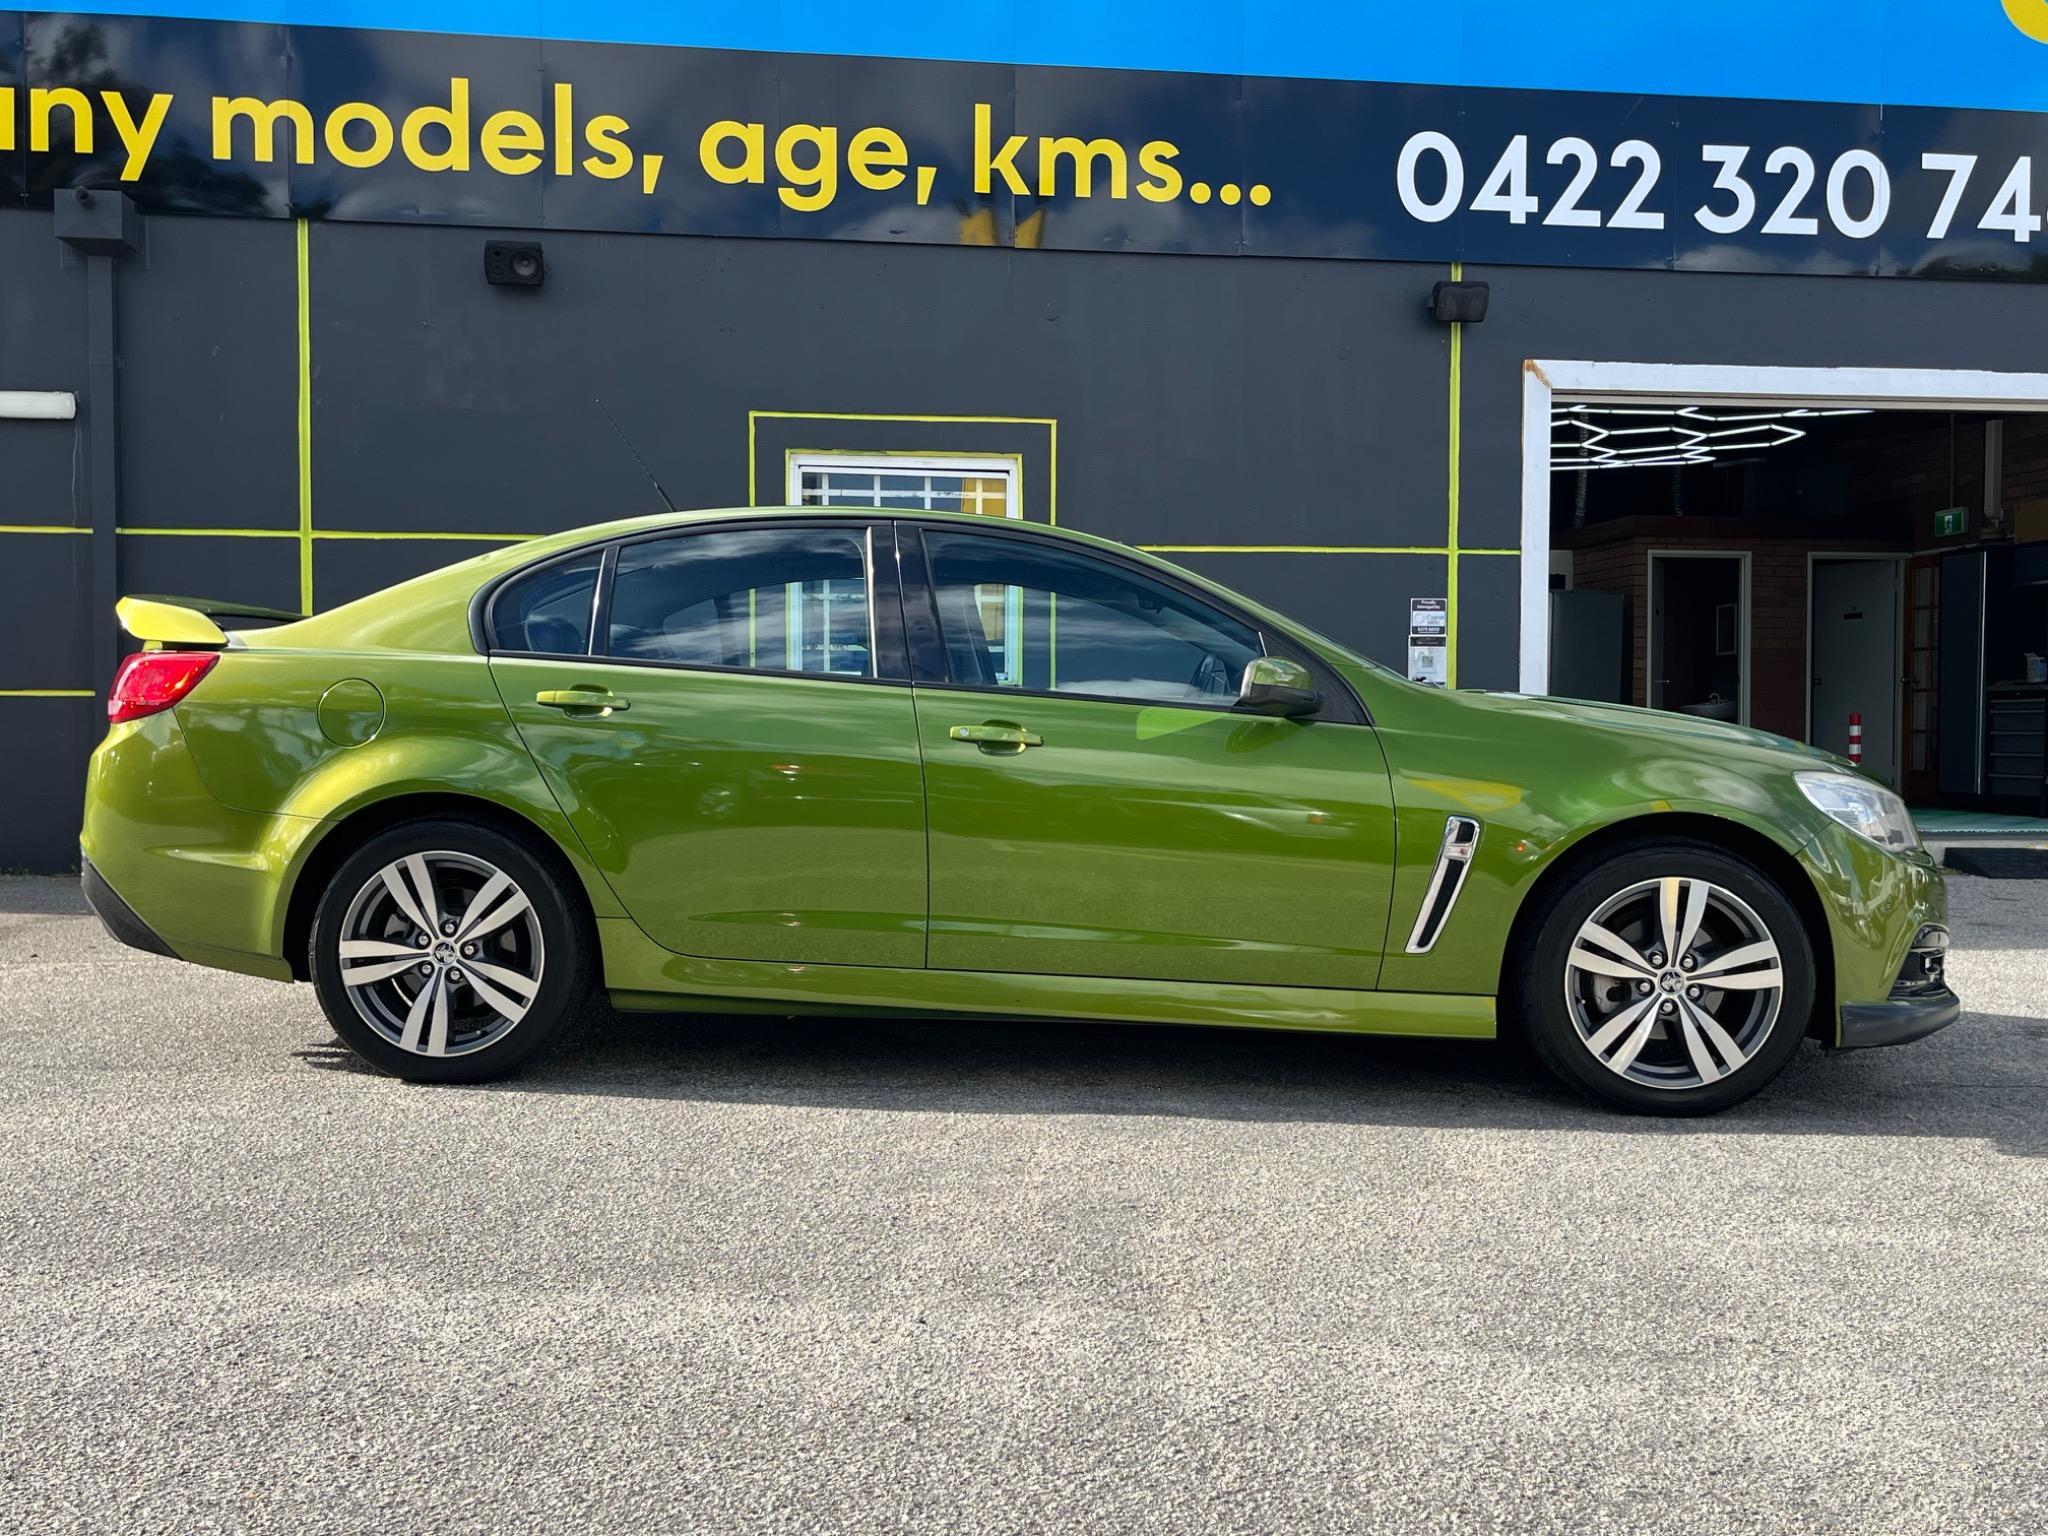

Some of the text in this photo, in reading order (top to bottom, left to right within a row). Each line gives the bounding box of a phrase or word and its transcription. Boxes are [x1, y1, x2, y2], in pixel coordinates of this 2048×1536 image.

[0, 78, 1271, 212] ny models, age, kms...
[1397, 131, 2048, 243] 0422 320 74
